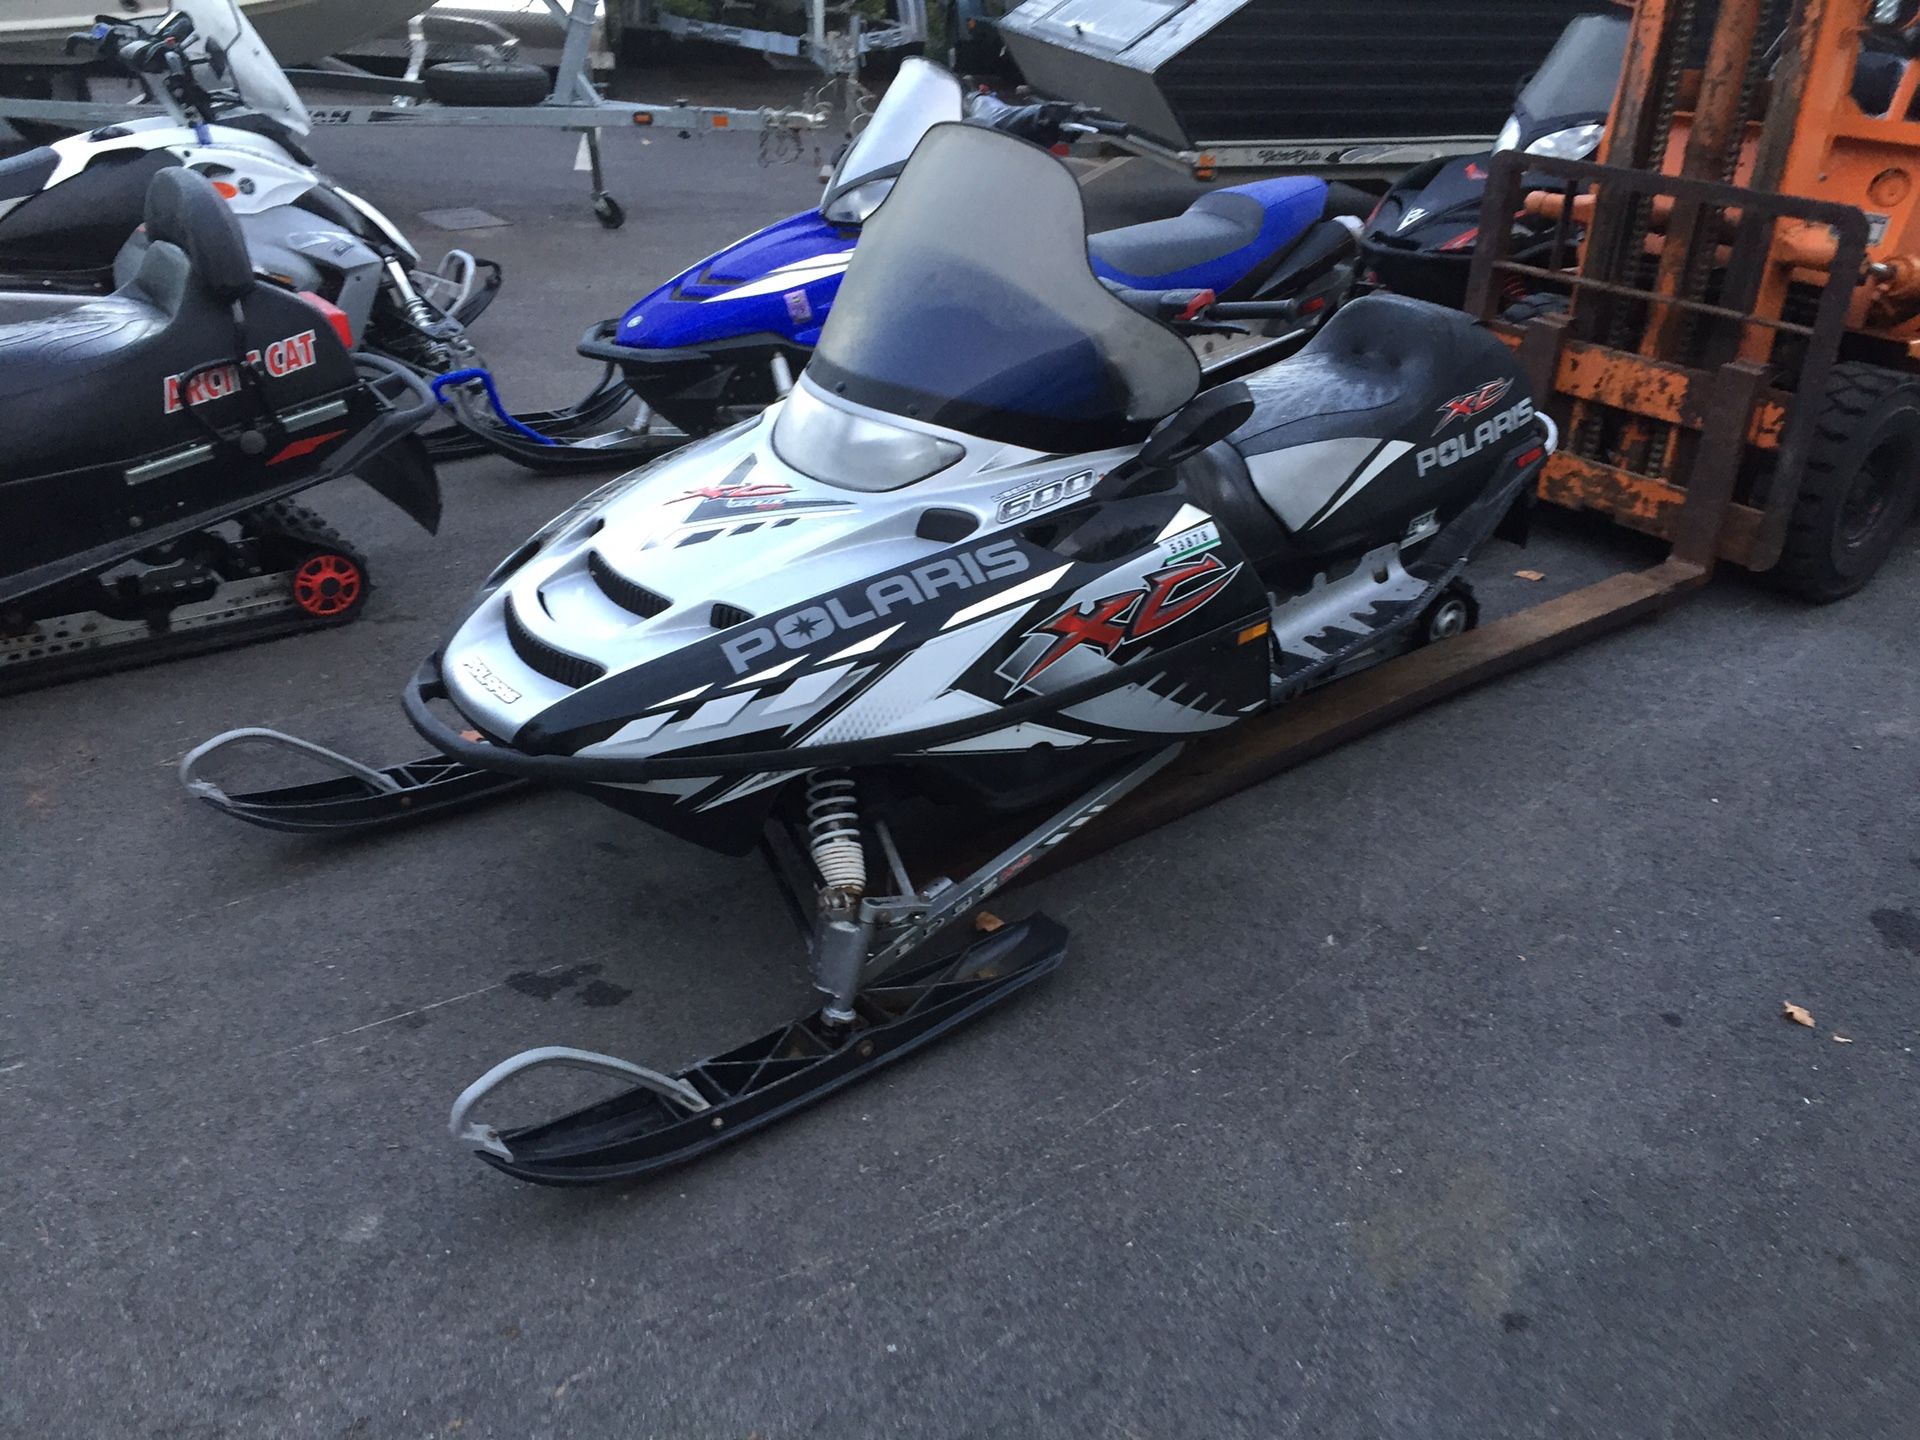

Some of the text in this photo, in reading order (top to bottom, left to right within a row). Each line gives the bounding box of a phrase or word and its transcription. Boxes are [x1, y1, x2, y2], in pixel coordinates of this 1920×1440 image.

[265, 329, 317, 378] CAT
[1416, 396, 1534, 477] POLARIS
[996, 468, 1096, 524] 600
[721, 539, 1030, 675] POLARIS
[1004, 553, 1244, 699] XC
